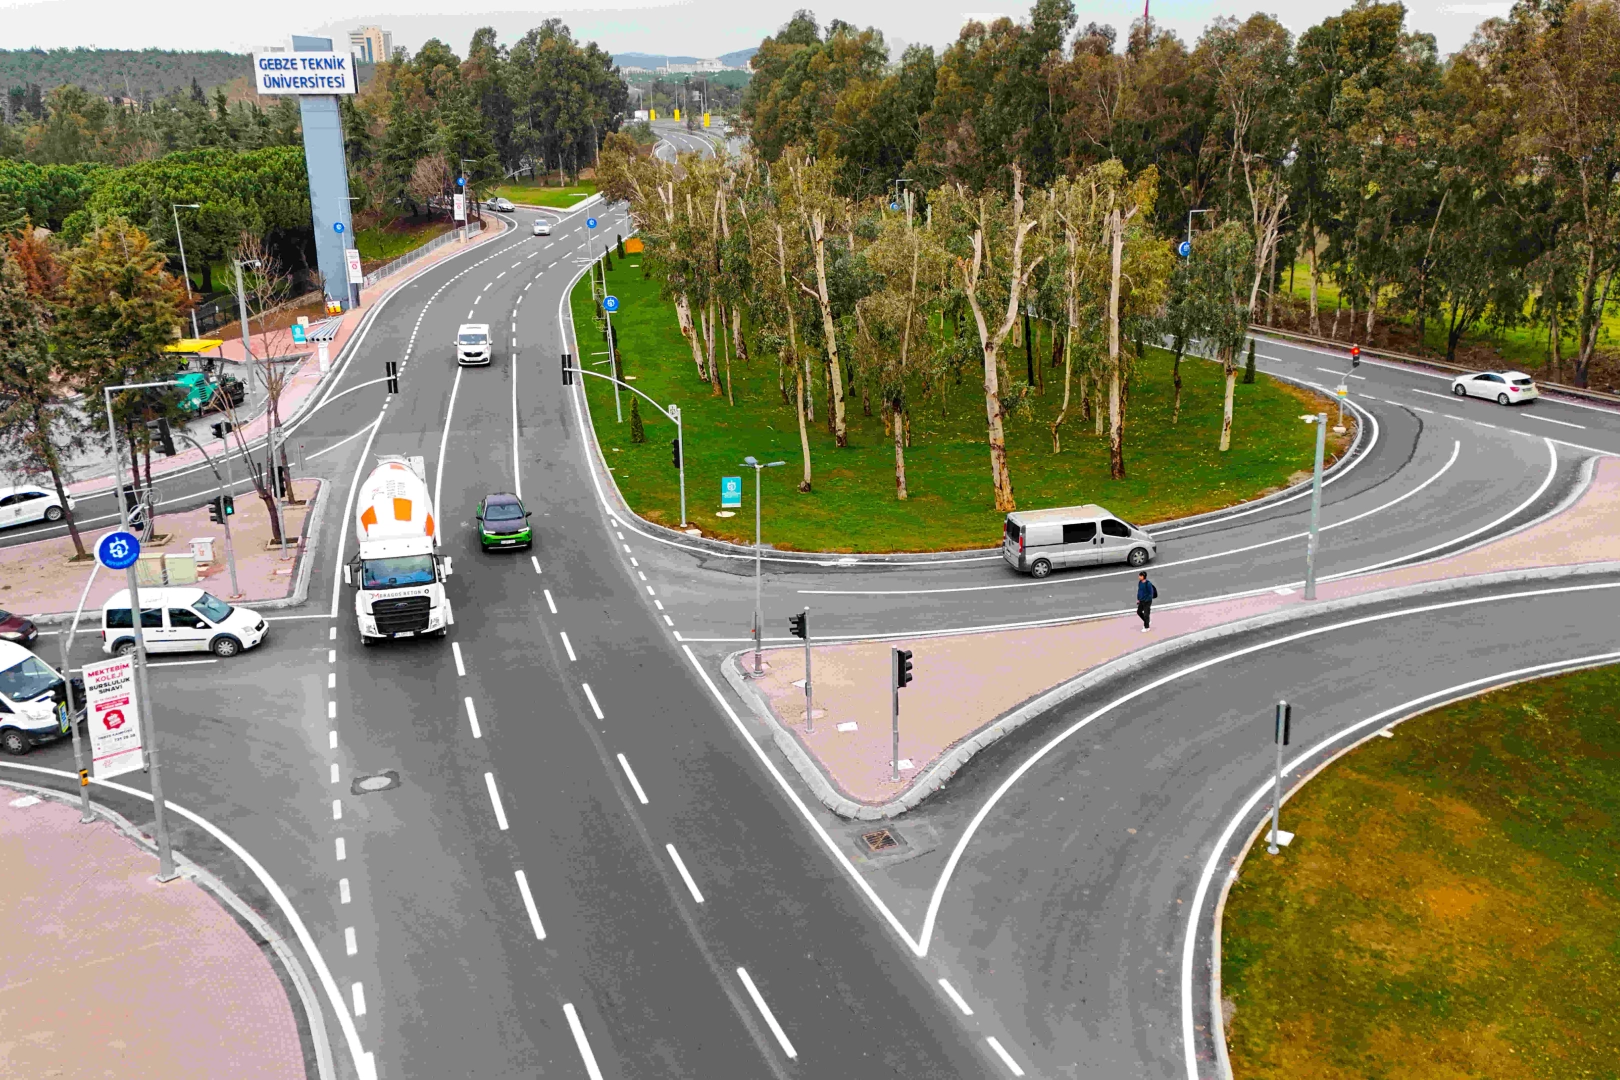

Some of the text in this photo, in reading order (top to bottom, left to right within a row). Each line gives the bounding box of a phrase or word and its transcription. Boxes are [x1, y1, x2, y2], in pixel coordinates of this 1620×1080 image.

[259, 55, 346, 70] GEBZE TEKNİK
[263, 74, 345, 88] ÜNİVERSİTESİ
[88, 663, 130, 677] MEKTEBİM
[95, 671, 123, 683] KOLEJİ
[88, 677, 130, 691] BURSLULUK
